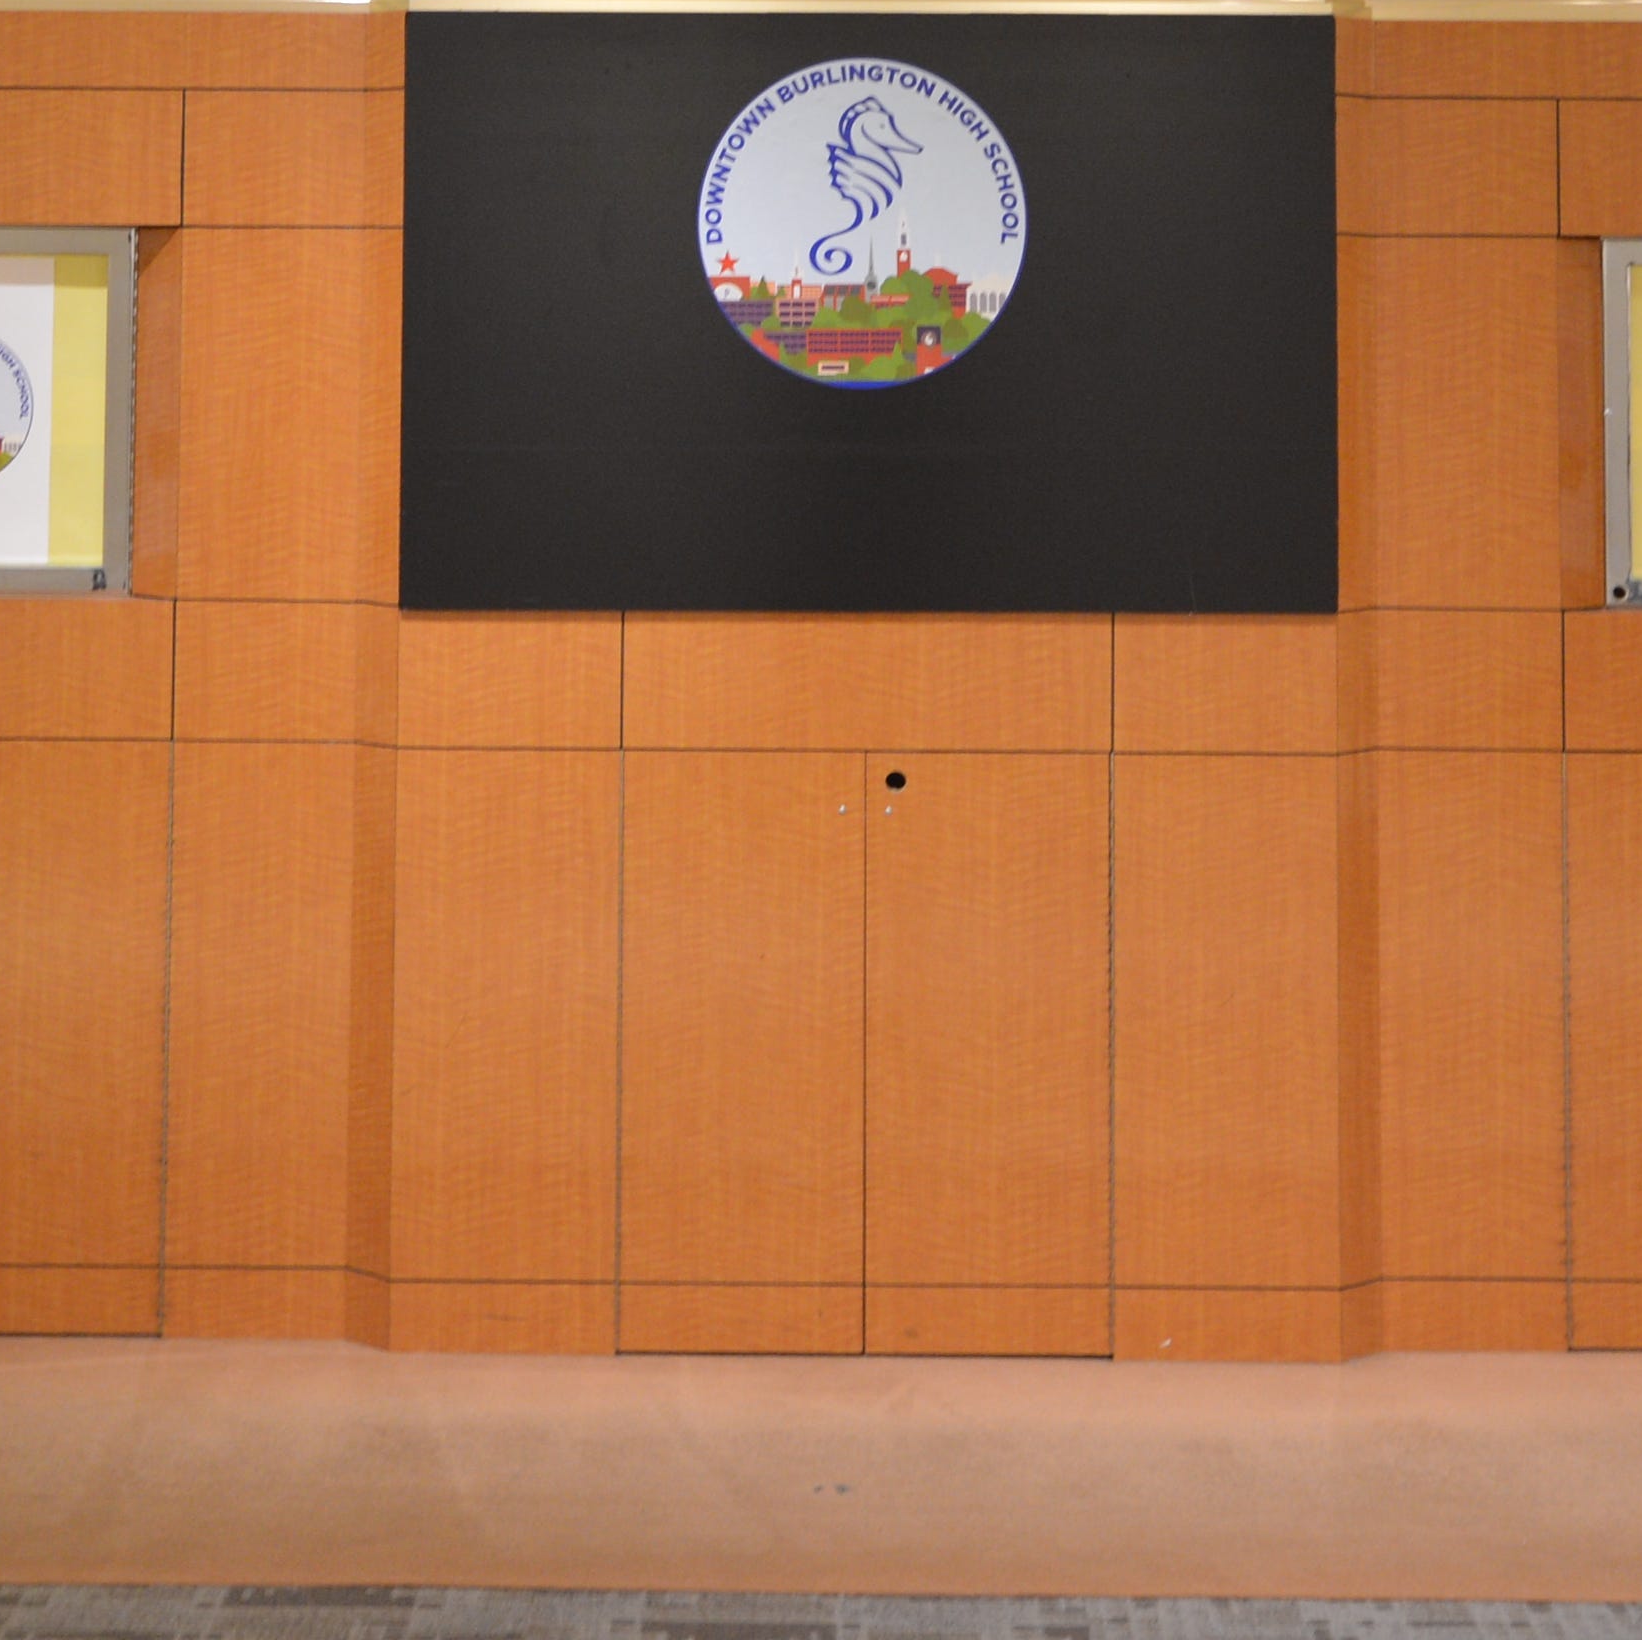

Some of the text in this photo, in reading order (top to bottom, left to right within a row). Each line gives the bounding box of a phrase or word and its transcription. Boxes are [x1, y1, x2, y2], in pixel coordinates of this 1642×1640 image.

[705, 64, 1018, 245] DOWNTOWN BURLINGTON HIGH SCHOOL
